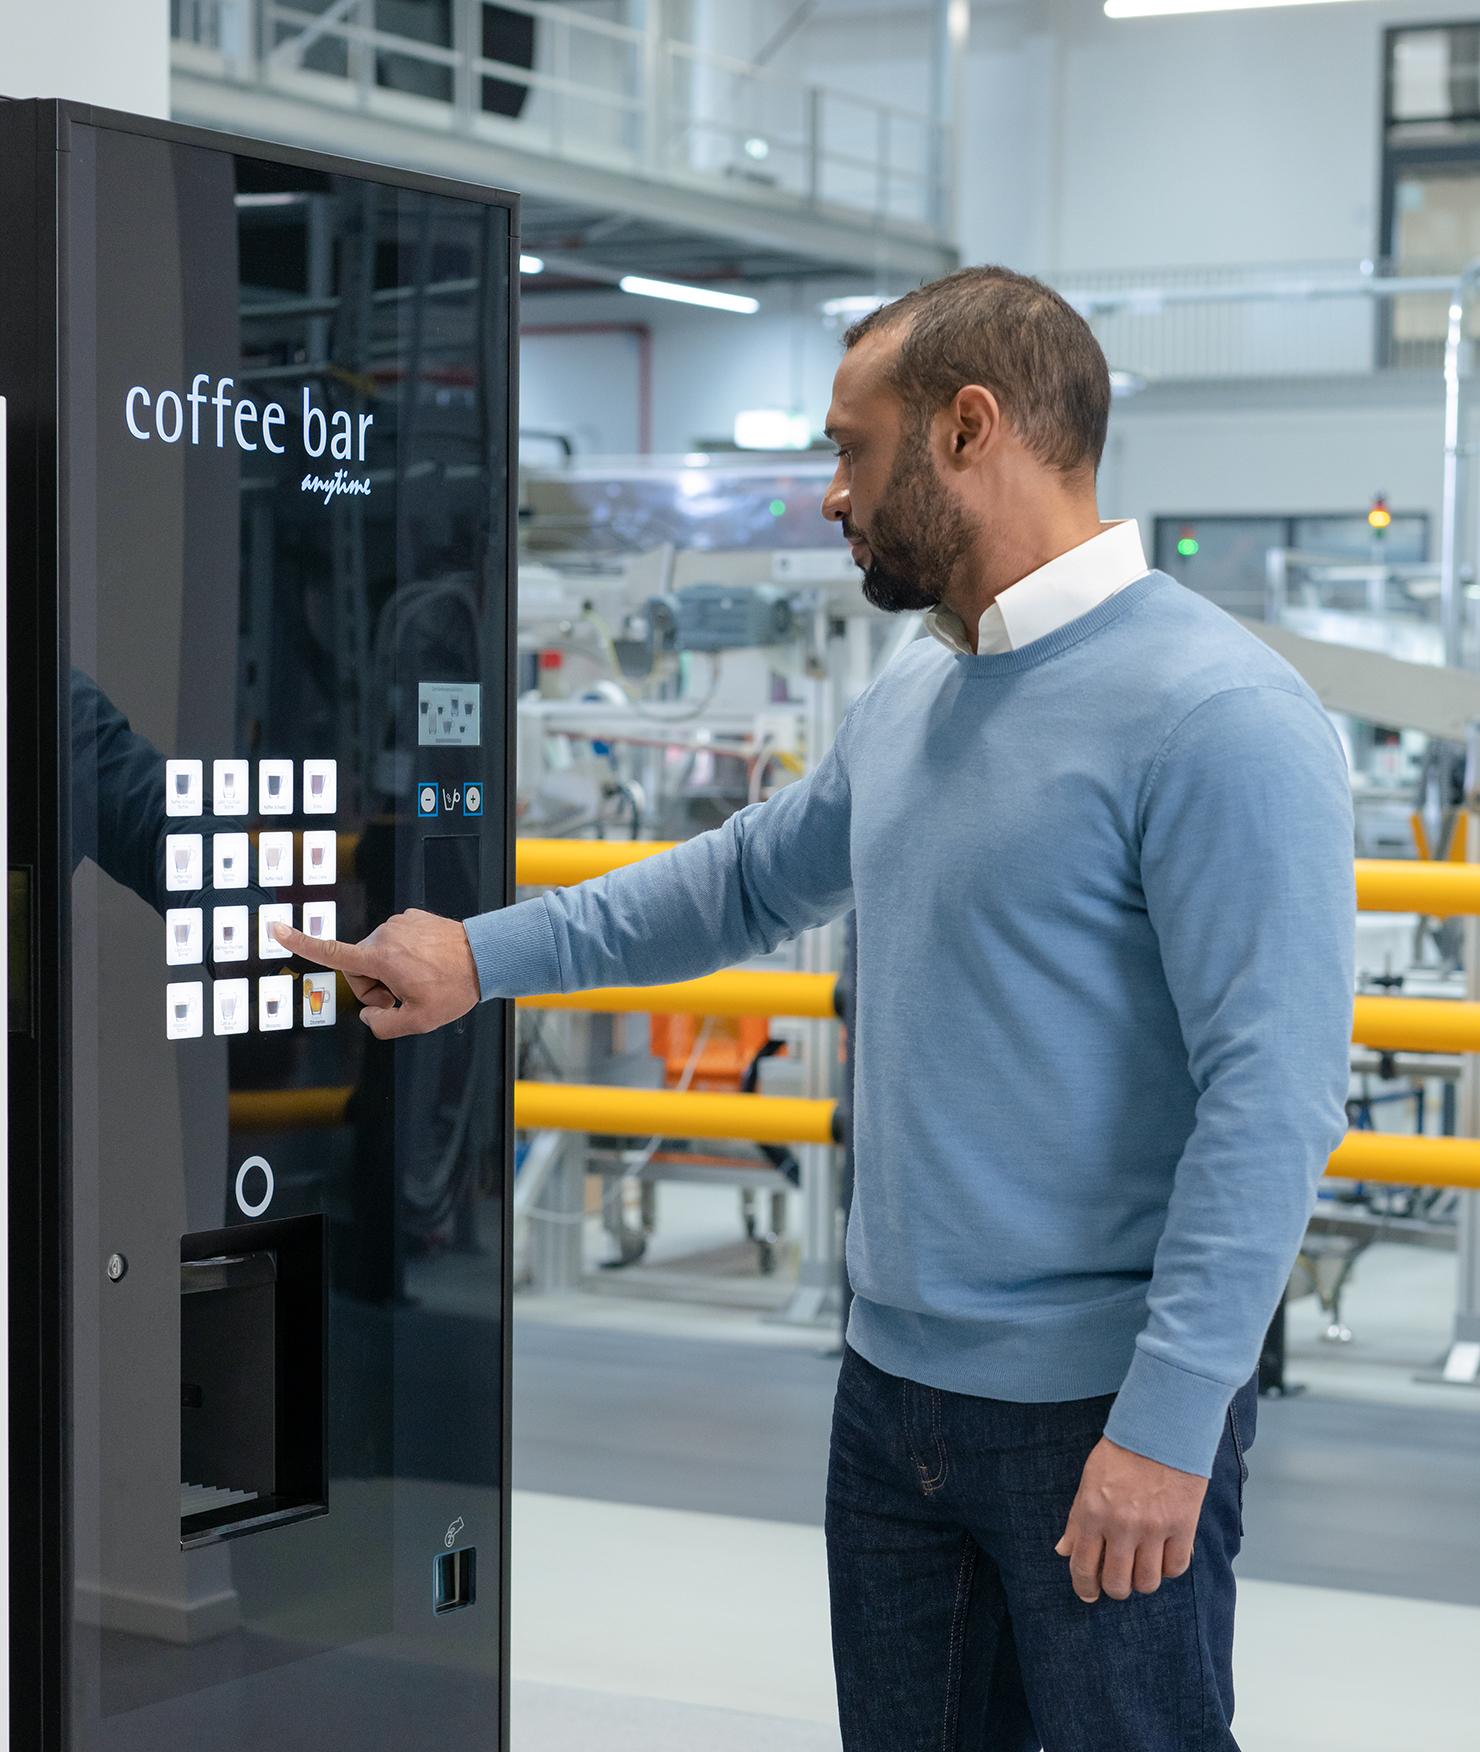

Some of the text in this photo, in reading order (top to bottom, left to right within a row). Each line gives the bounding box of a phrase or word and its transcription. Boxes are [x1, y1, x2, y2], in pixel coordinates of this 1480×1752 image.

[125, 373, 373, 462] coffee bar
[301, 468, 371, 505] anytime
